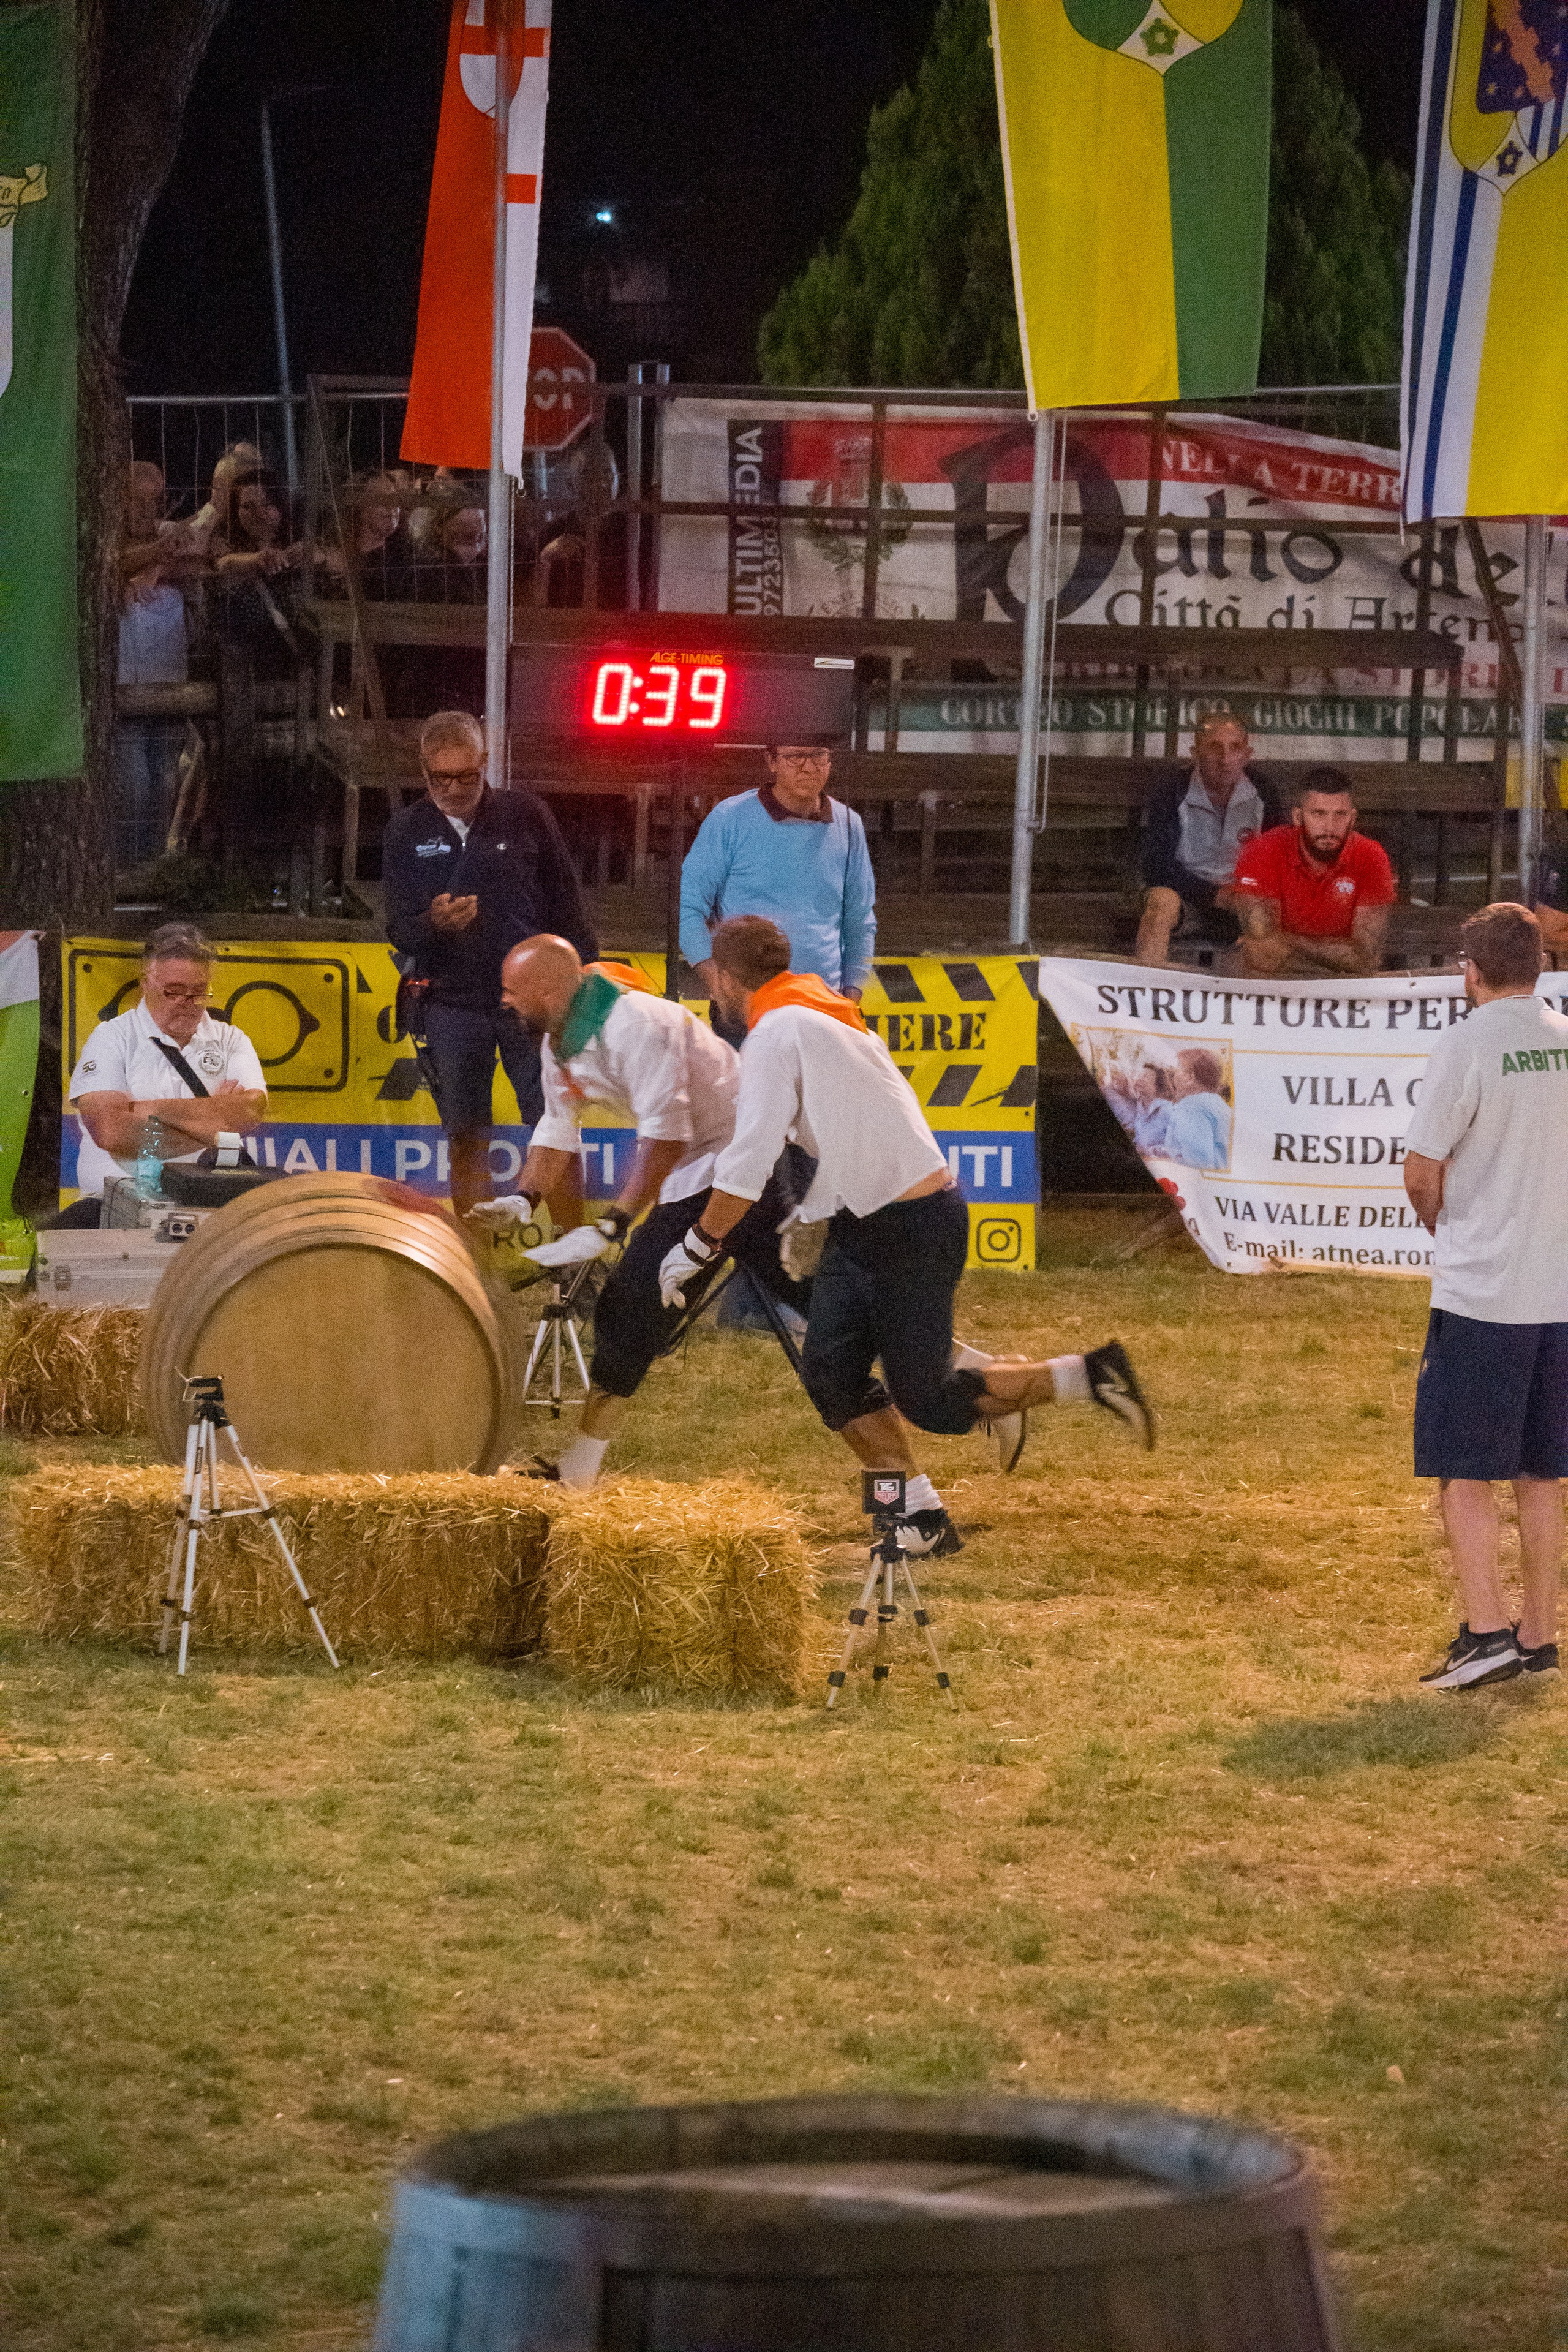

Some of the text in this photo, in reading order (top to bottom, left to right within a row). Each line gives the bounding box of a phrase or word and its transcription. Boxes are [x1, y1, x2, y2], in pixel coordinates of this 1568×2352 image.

[1267, 594, 1316, 630] di
[650, 652, 723, 666] ALGE-TIMING
[592, 663, 726, 729] 0:39
[940, 697, 1073, 726] CORO
[1253, 699, 1357, 732] GIOCHI
[1097, 984, 1371, 1030] STRUTTURE
[1282, 1076, 1395, 1107] VILLA
[1215, 1196, 1257, 1223] VIA
[1264, 1202, 1351, 1227] VALLE
